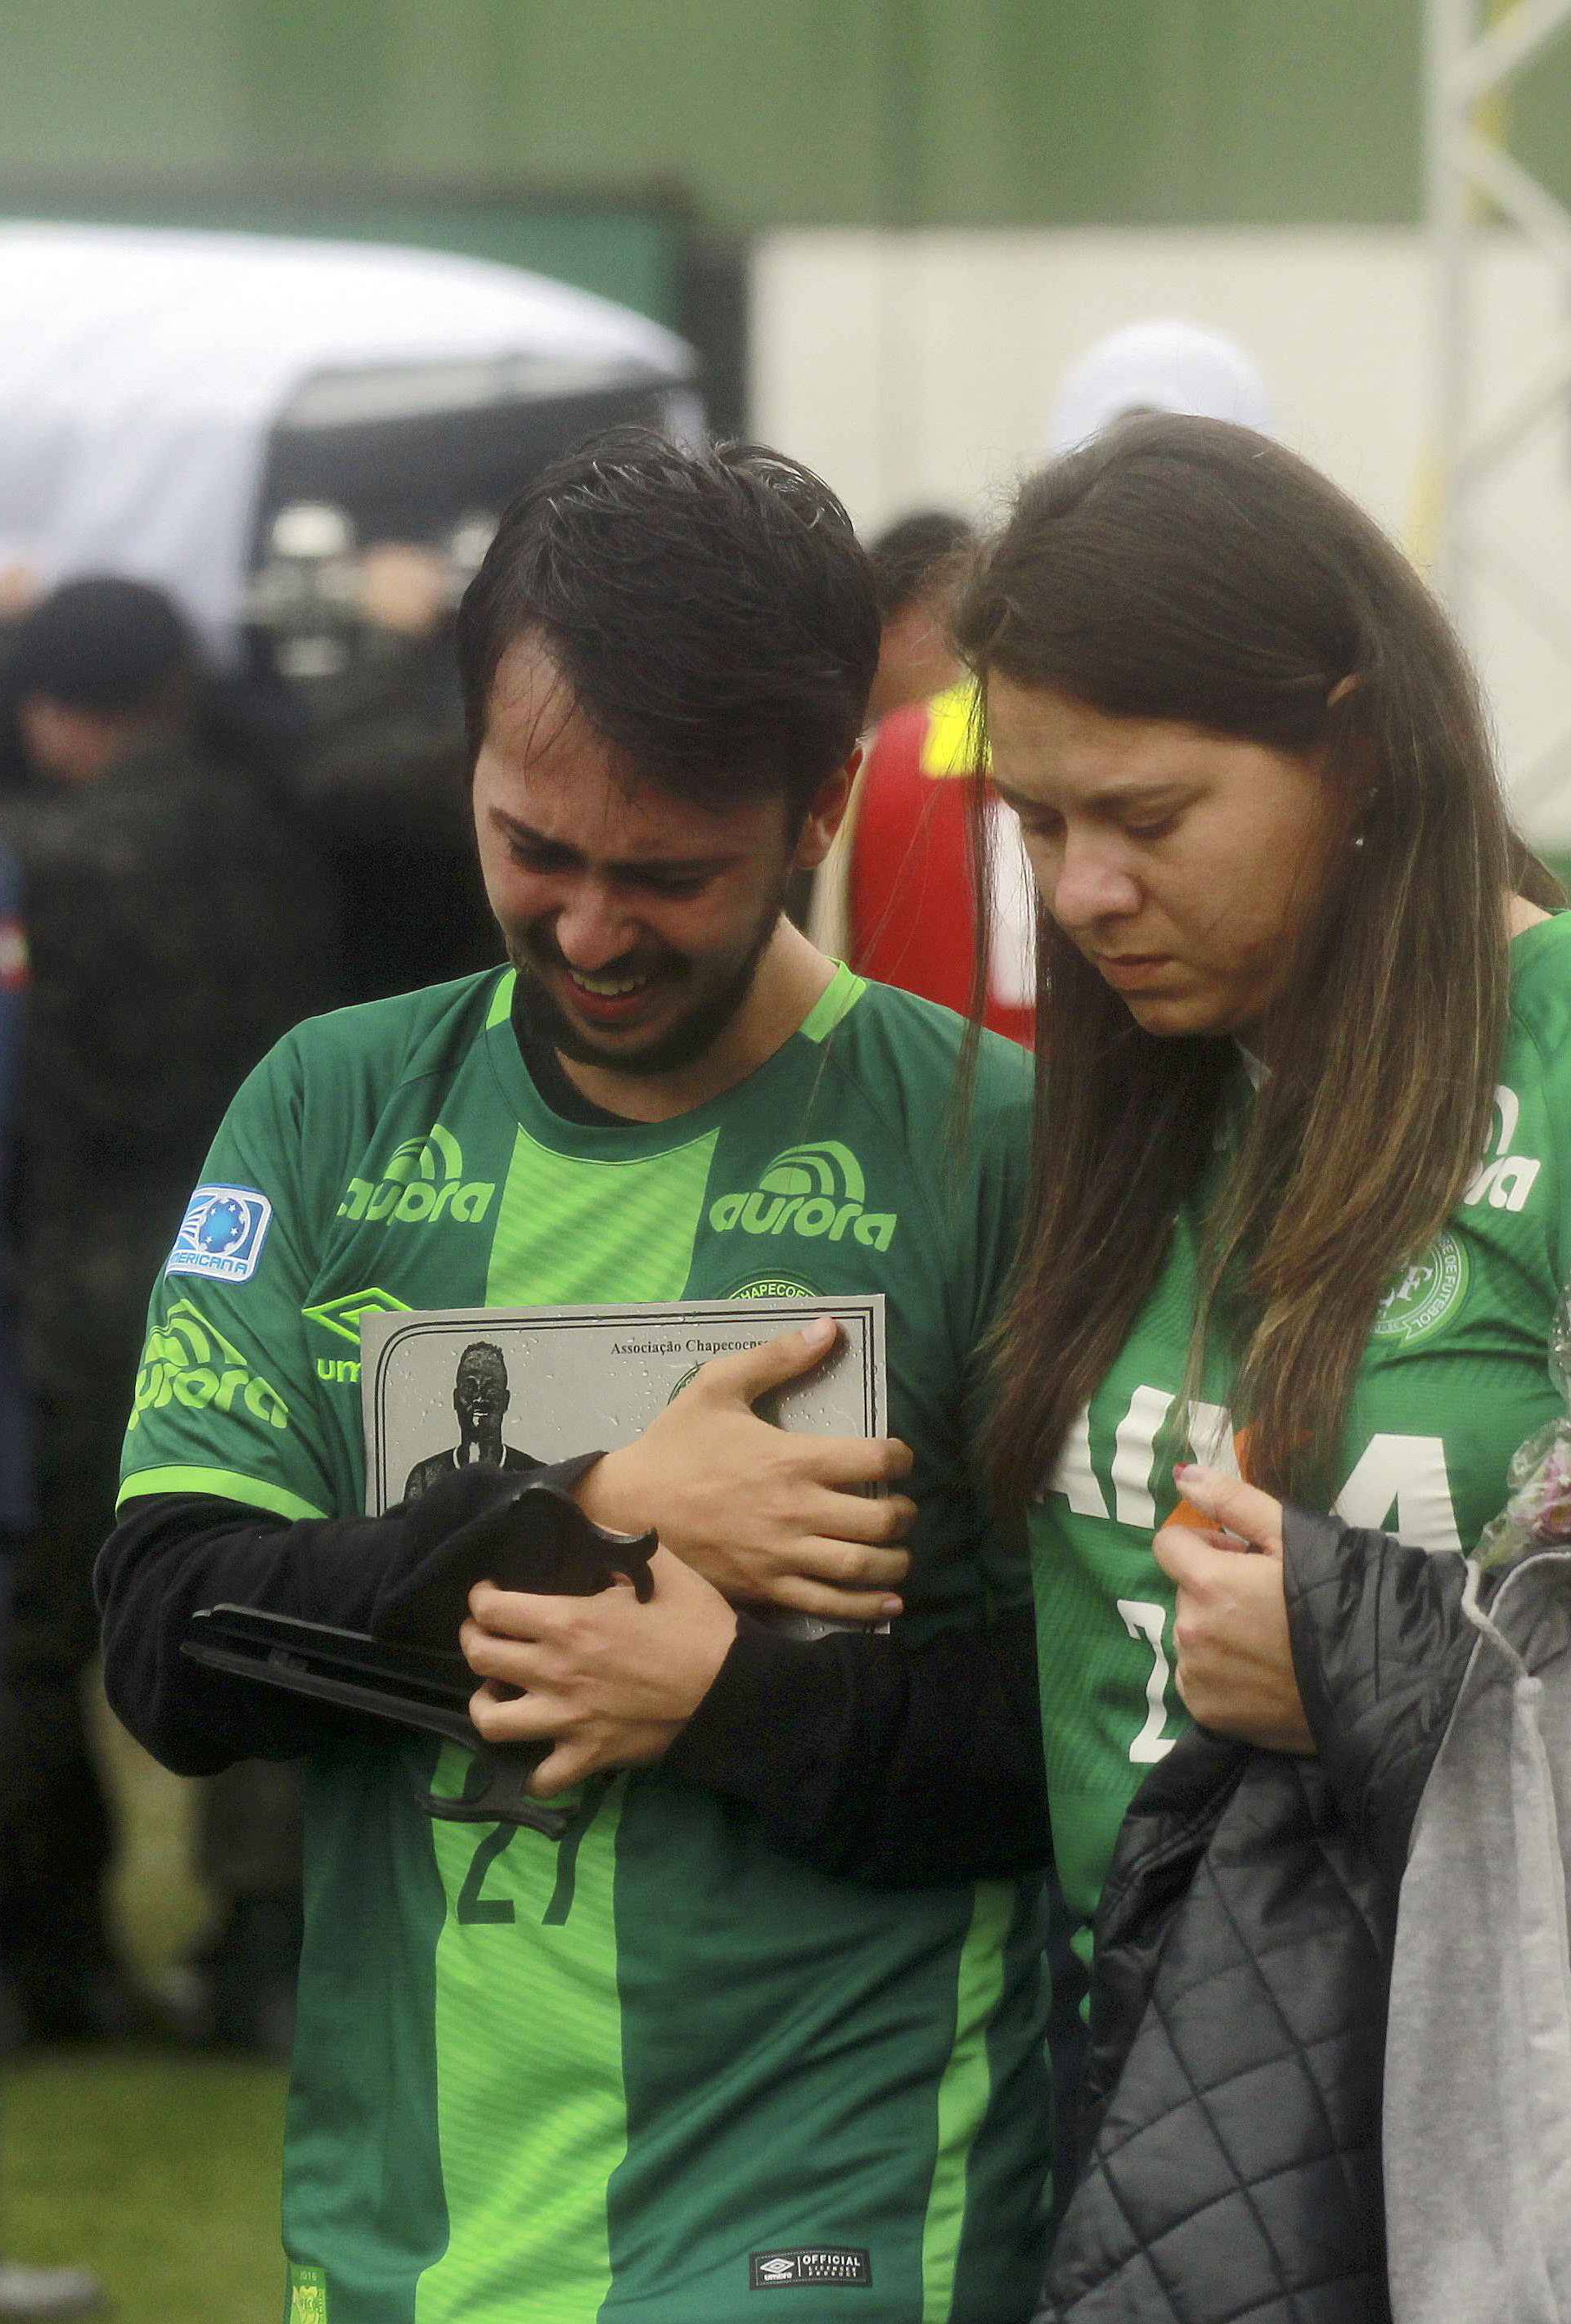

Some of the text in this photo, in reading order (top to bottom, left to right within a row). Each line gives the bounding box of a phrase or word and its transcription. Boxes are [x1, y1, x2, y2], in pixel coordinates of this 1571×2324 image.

[709, 1192, 898, 1252] aurora
[610, 1341, 682, 1355] Associação
[128, 1363, 288, 1430] urora
[803, 2254, 860, 2267] OFFICIAL
